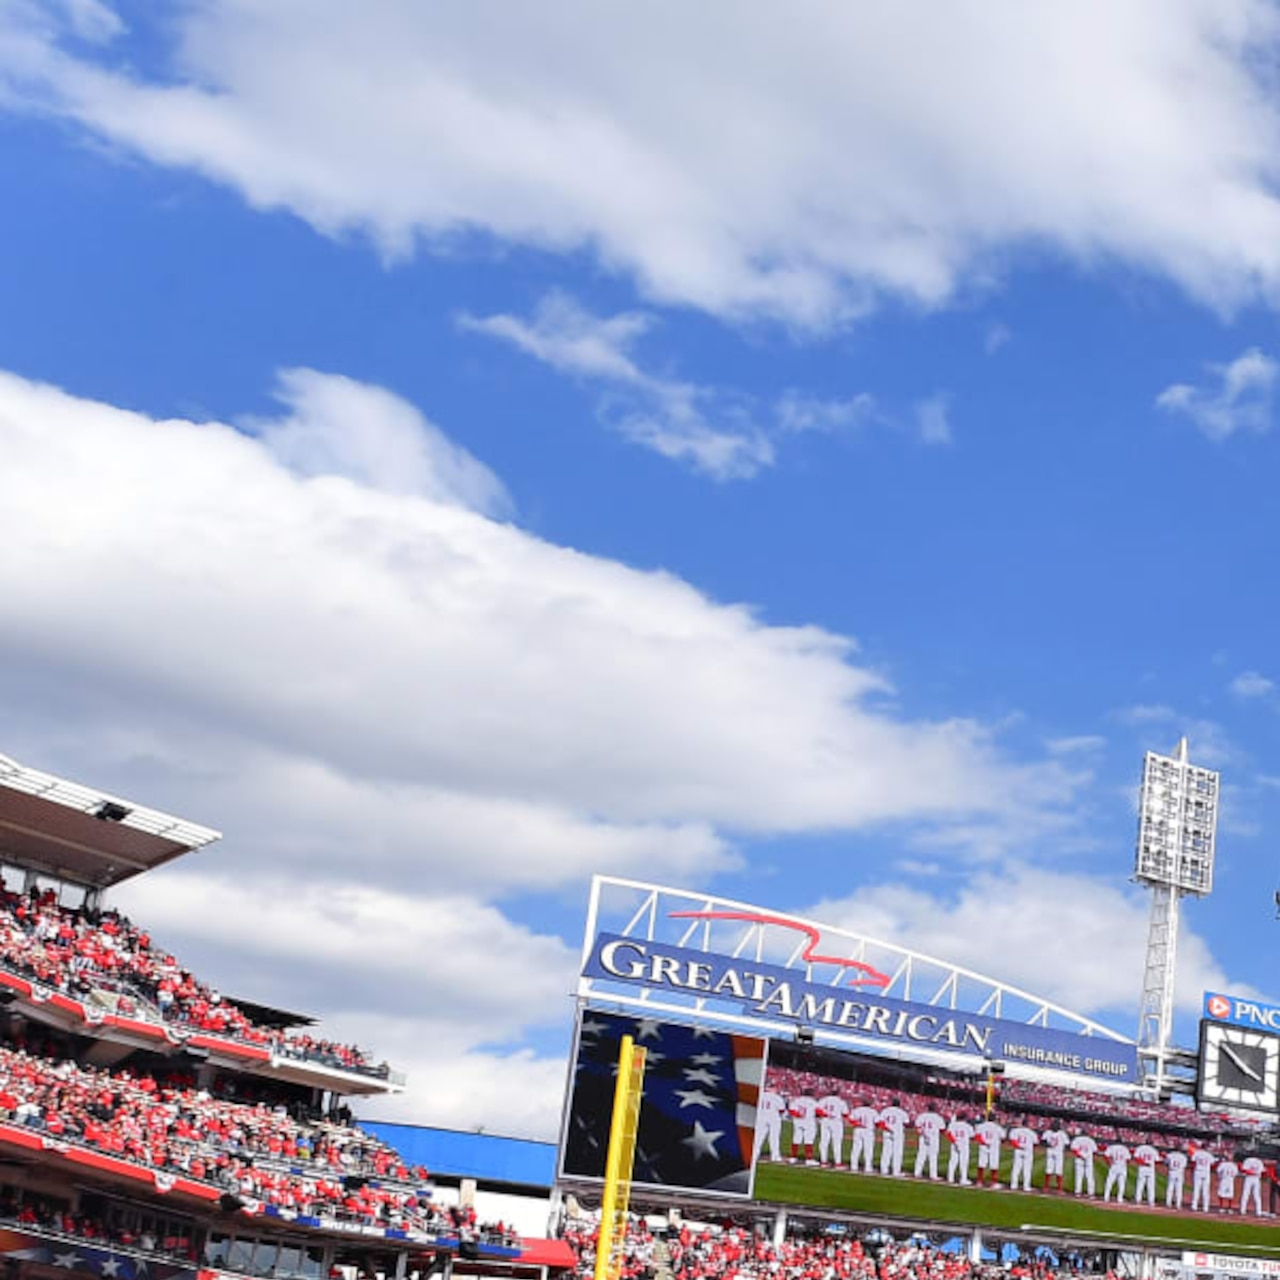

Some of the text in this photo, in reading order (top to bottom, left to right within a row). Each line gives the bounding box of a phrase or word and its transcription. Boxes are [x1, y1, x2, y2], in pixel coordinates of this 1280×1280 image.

[1003, 1042, 1081, 1068] INSURANCE
[1084, 1057, 1128, 1076] GROUP
[1213, 1257, 1259, 1271] TOYOTA
